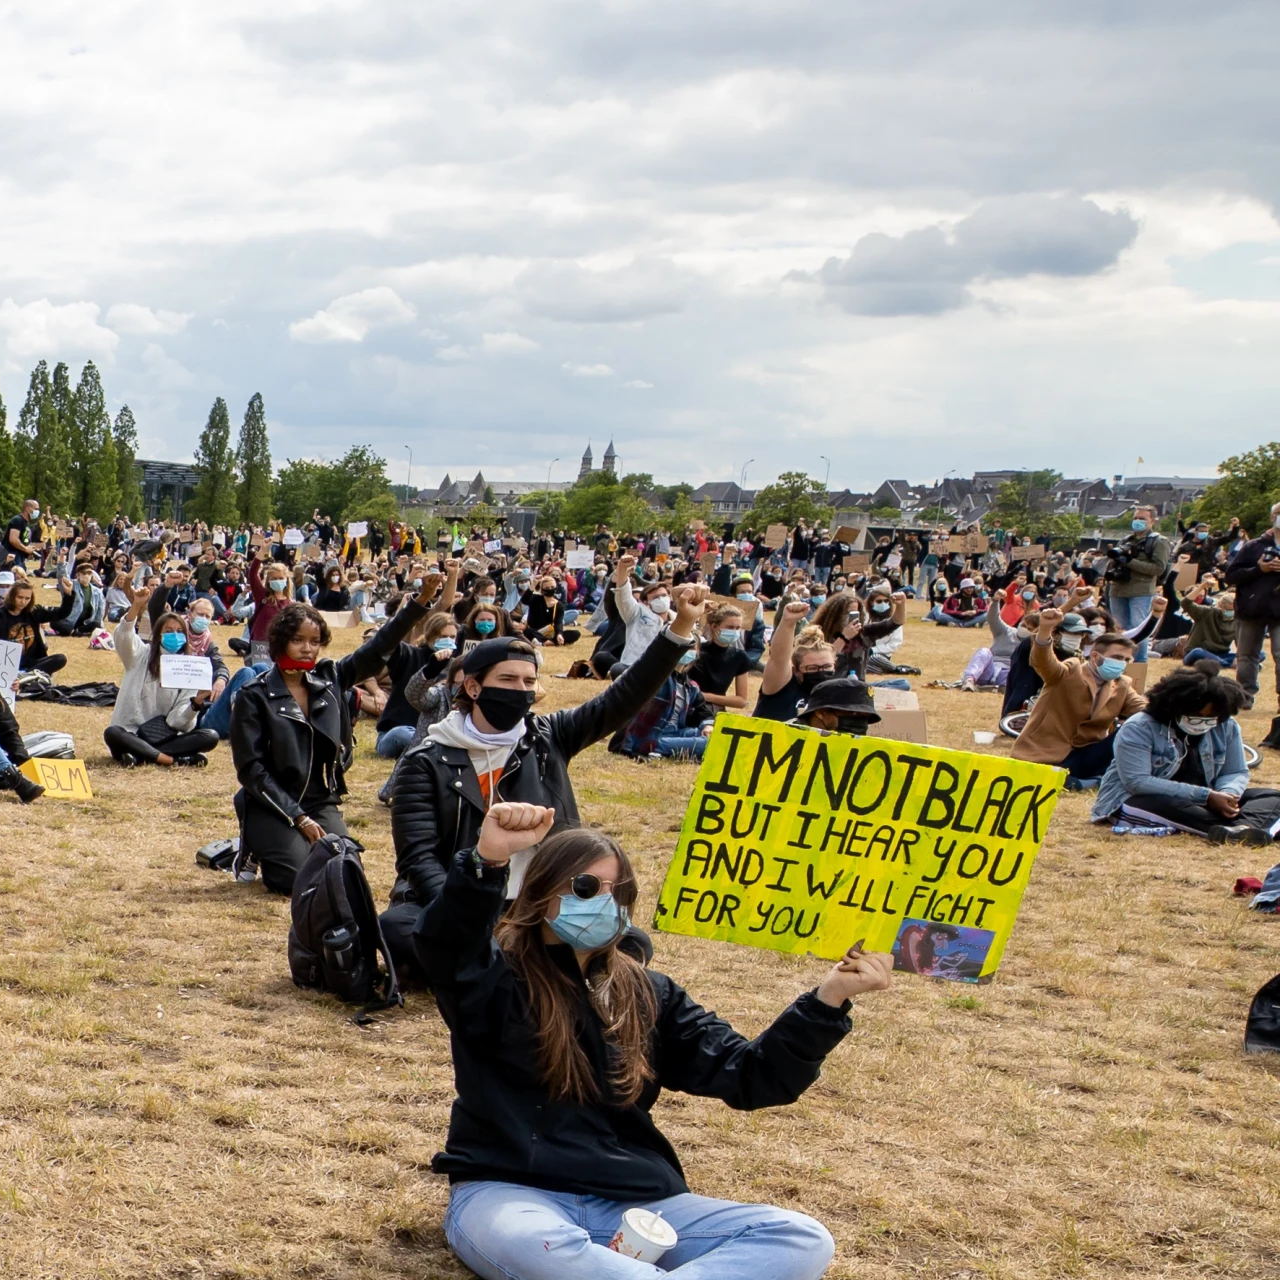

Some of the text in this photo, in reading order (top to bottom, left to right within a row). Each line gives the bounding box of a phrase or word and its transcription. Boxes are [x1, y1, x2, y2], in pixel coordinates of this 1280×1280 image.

[40, 763, 88, 793] BLM
[801, 743, 932, 820] NOT
[917, 761, 1056, 843] BLACK
[683, 840, 995, 927] AND I WILL FIGHT
[695, 795, 1024, 885] BUT I HEAR YOU
[674, 887, 820, 937] FOR YOU
